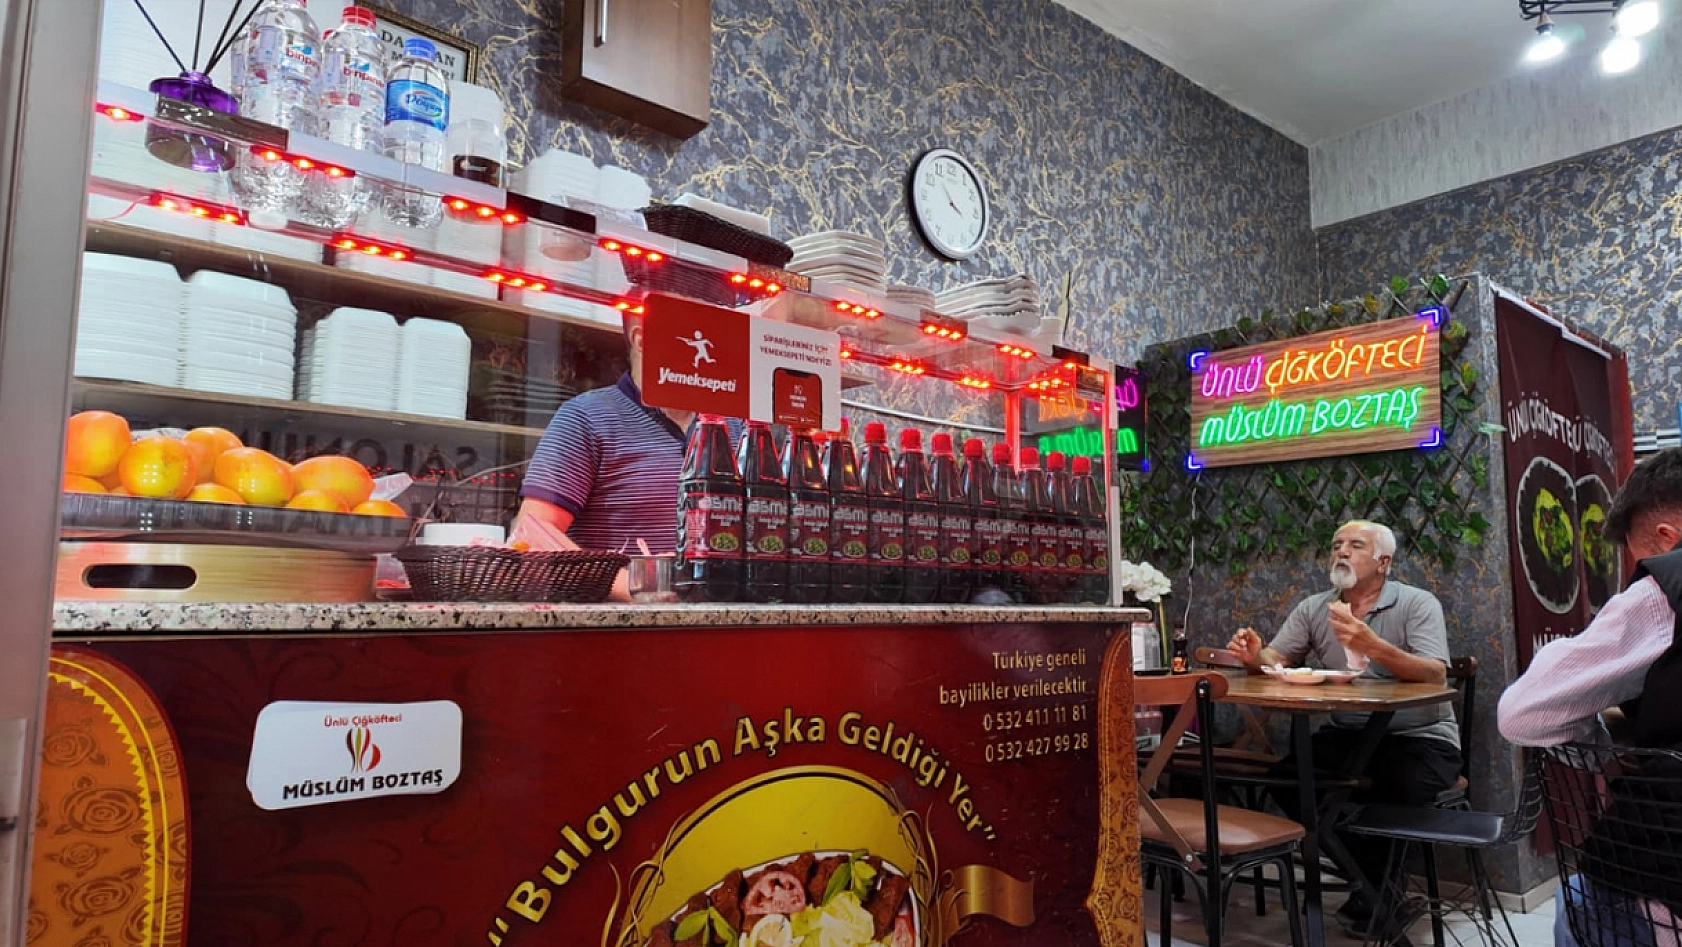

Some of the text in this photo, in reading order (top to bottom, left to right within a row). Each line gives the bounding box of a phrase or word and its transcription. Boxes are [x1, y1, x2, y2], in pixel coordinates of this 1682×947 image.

[658, 366, 737, 393] Yemeksepeti
[1201, 355, 1264, 398] ÜNLÜ
[1199, 386, 1424, 447] MÜSLÜM BOZTAŞ
[992, 648, 1087, 672] Türkiye geneli
[938, 675, 1088, 708] bayilikler verilecektir
[324, 713, 349, 727] Ünlü
[984, 704, 1087, 731] 0 532 411 11 81
[733, 707, 826, 757] Aşka
[837, 711, 950, 789] Geldiği
[985, 732, 1089, 762] 0 532 427 99 28
[282, 768, 443, 800] MÜSLÜM BOZTAŞ
